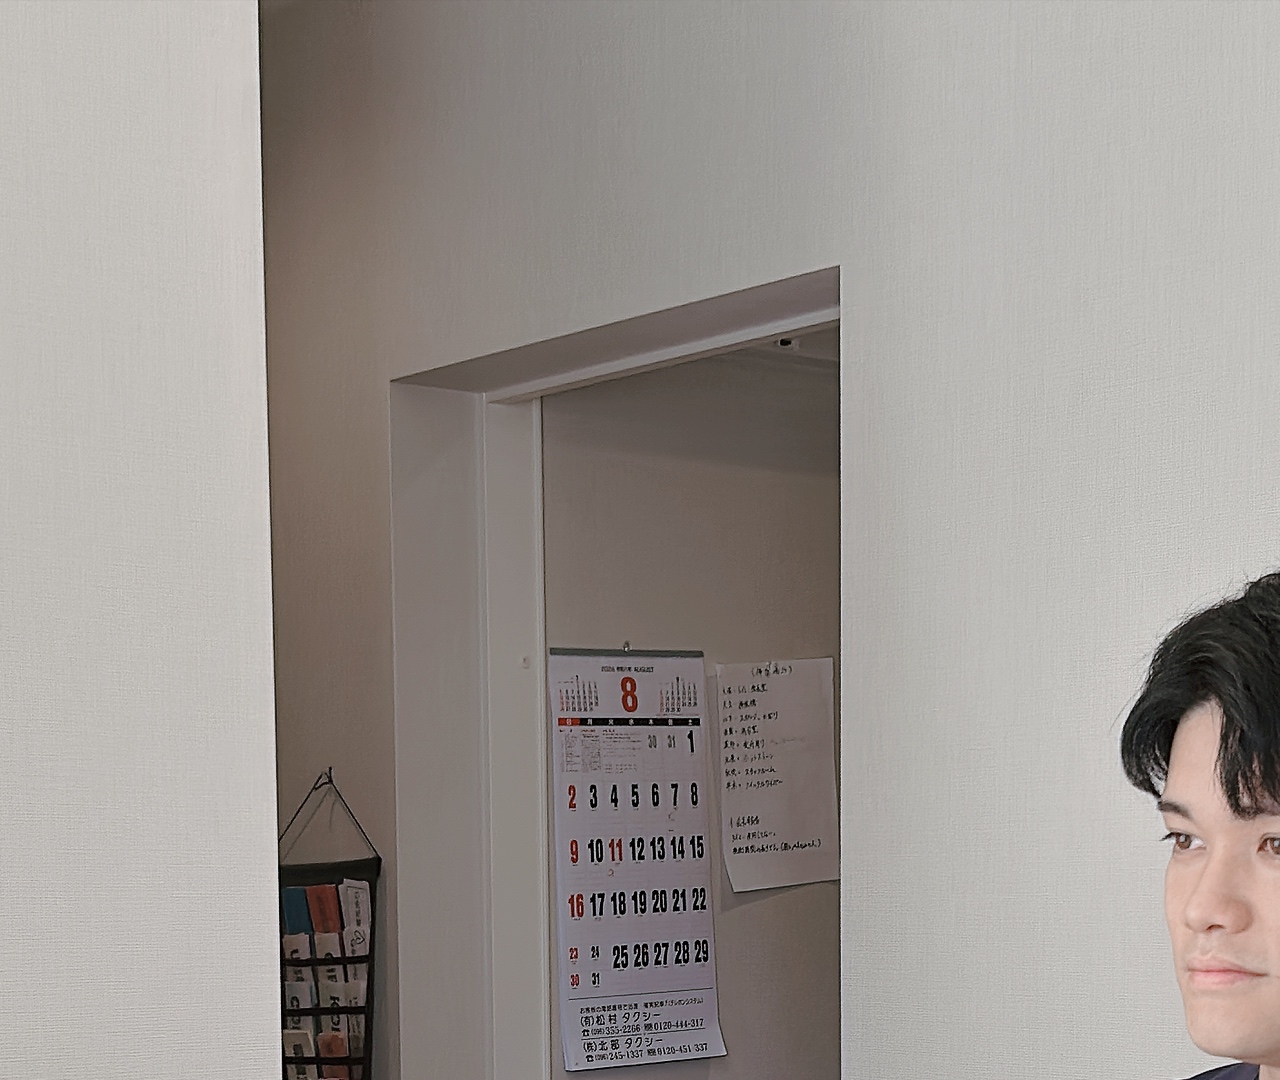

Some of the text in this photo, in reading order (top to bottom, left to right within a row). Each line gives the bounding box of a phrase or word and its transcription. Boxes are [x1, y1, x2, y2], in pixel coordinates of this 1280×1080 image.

[620, 676, 639, 713] 8
[568, 782, 698, 809] 2 3 4 5 6 7 8
[570, 839, 579, 864] 9
[588, 838, 604, 863] 10
[609, 837, 623, 862] 11
[629, 837, 645, 861] 12
[650, 836, 665, 860] 13
[670, 836, 685, 860] 14
[689, 835, 704, 859] 15
[568, 887, 707, 917] 16 17 18 19 20 21 22
[569, 939, 709, 968] 23 24 25 26 27 28 29
[570, 972, 600, 987] 30 31
